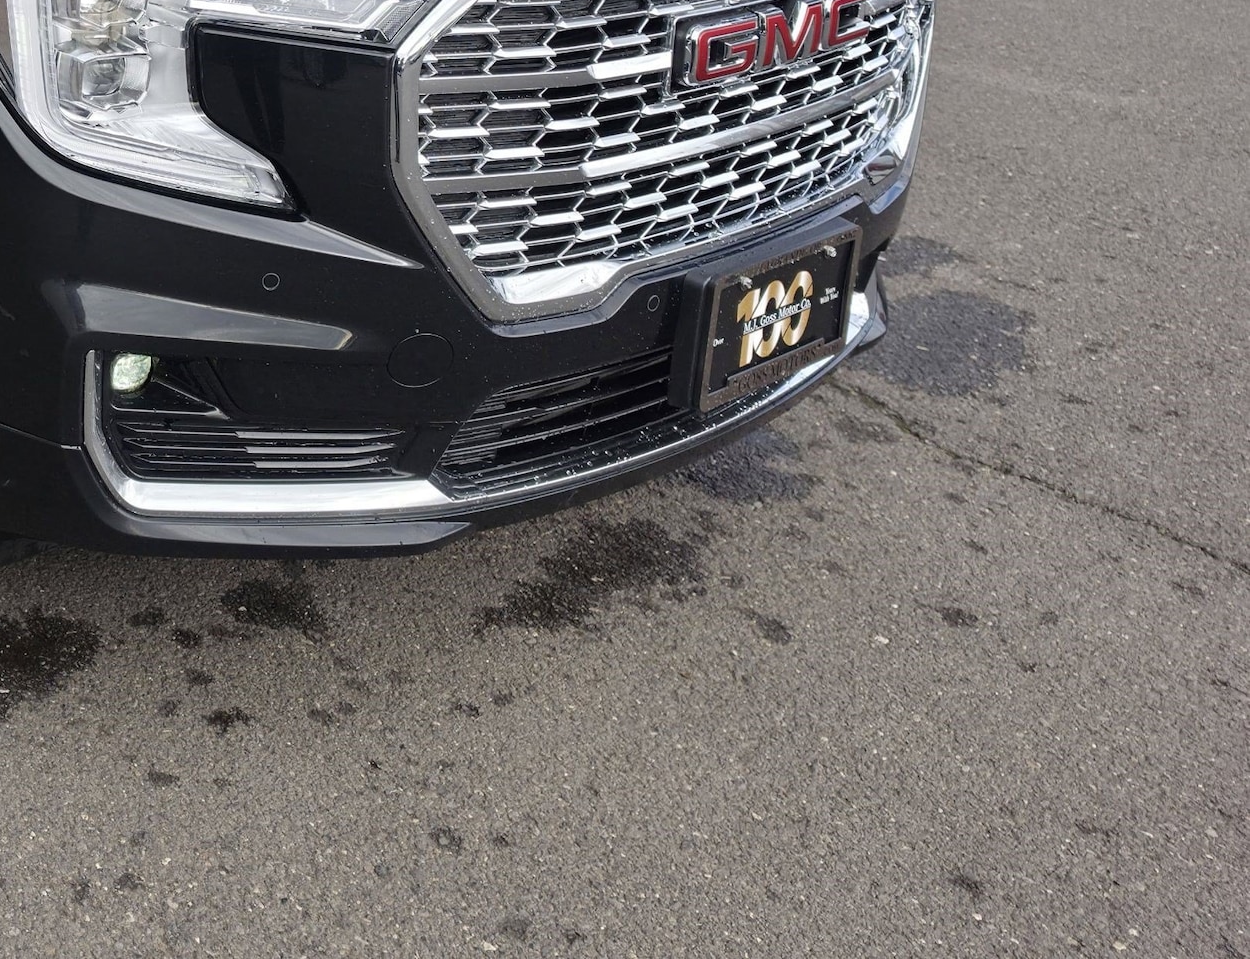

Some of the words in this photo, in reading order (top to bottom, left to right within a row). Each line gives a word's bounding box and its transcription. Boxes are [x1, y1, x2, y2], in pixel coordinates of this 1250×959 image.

[736, 270, 814, 368] 100
[743, 319, 759, 335] M.J.
[759, 311, 778, 328] Goss
[778, 301, 801, 321] Motor
[800, 296, 812, 311] Co.
